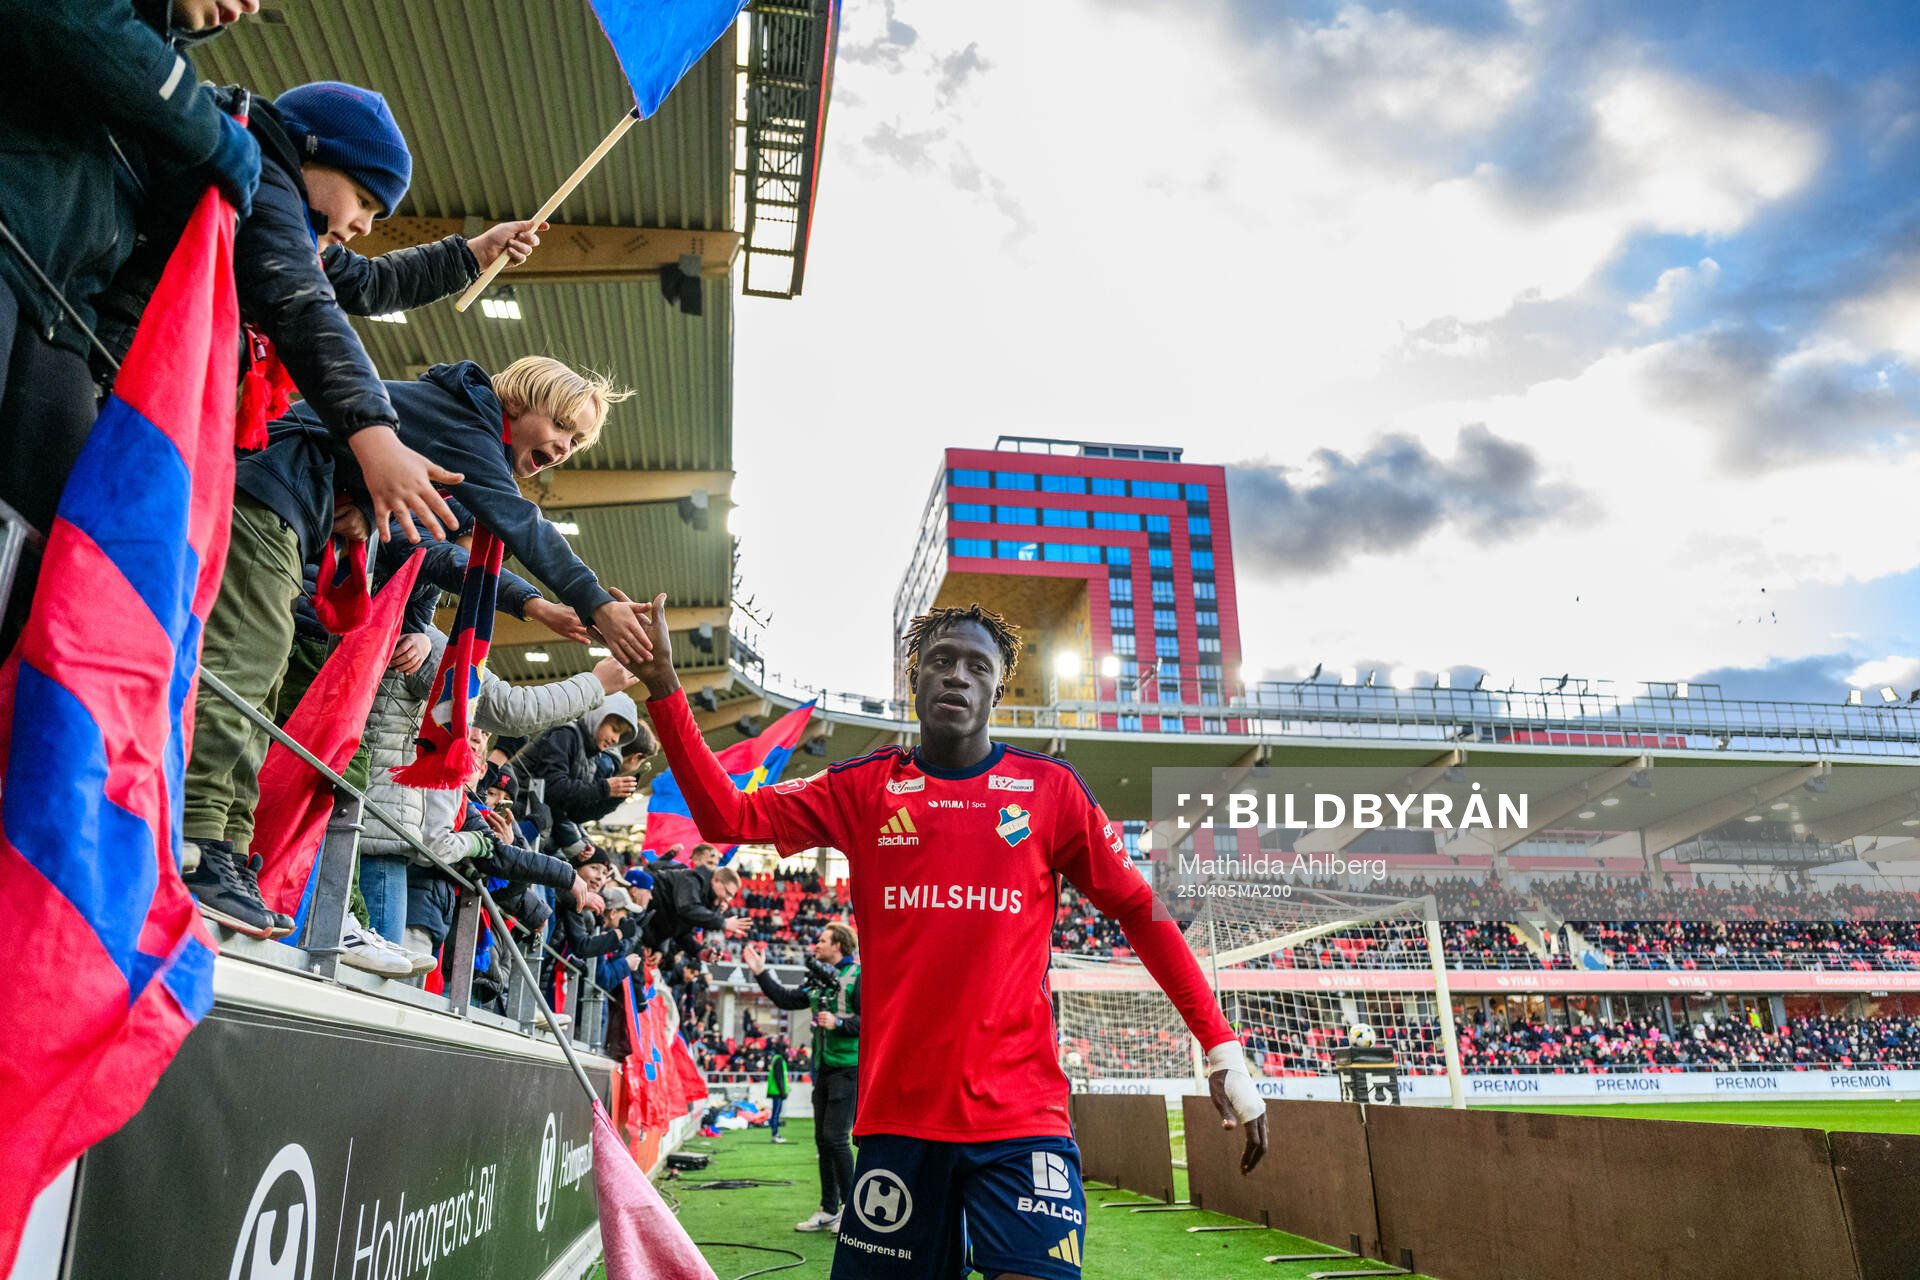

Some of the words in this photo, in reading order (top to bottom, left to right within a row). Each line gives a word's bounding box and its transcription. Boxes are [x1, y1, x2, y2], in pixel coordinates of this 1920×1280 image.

[940, 799, 964, 809] VISMA
[971, 801, 987, 809] Spcs
[877, 835, 919, 846] stadium
[884, 885, 1023, 914] EMILSHUS
[1473, 1079, 1538, 1092] PREMON
[1596, 1078, 1660, 1091] PREMON
[1715, 1077, 1777, 1089] PREMON
[1830, 1075, 1890, 1088] PREMON
[475, 1164, 497, 1238] Bil
[1017, 1196, 1082, 1225] BALCO
[839, 1232, 896, 1257] Holmgrens
[898, 1247, 912, 1260] Bil
